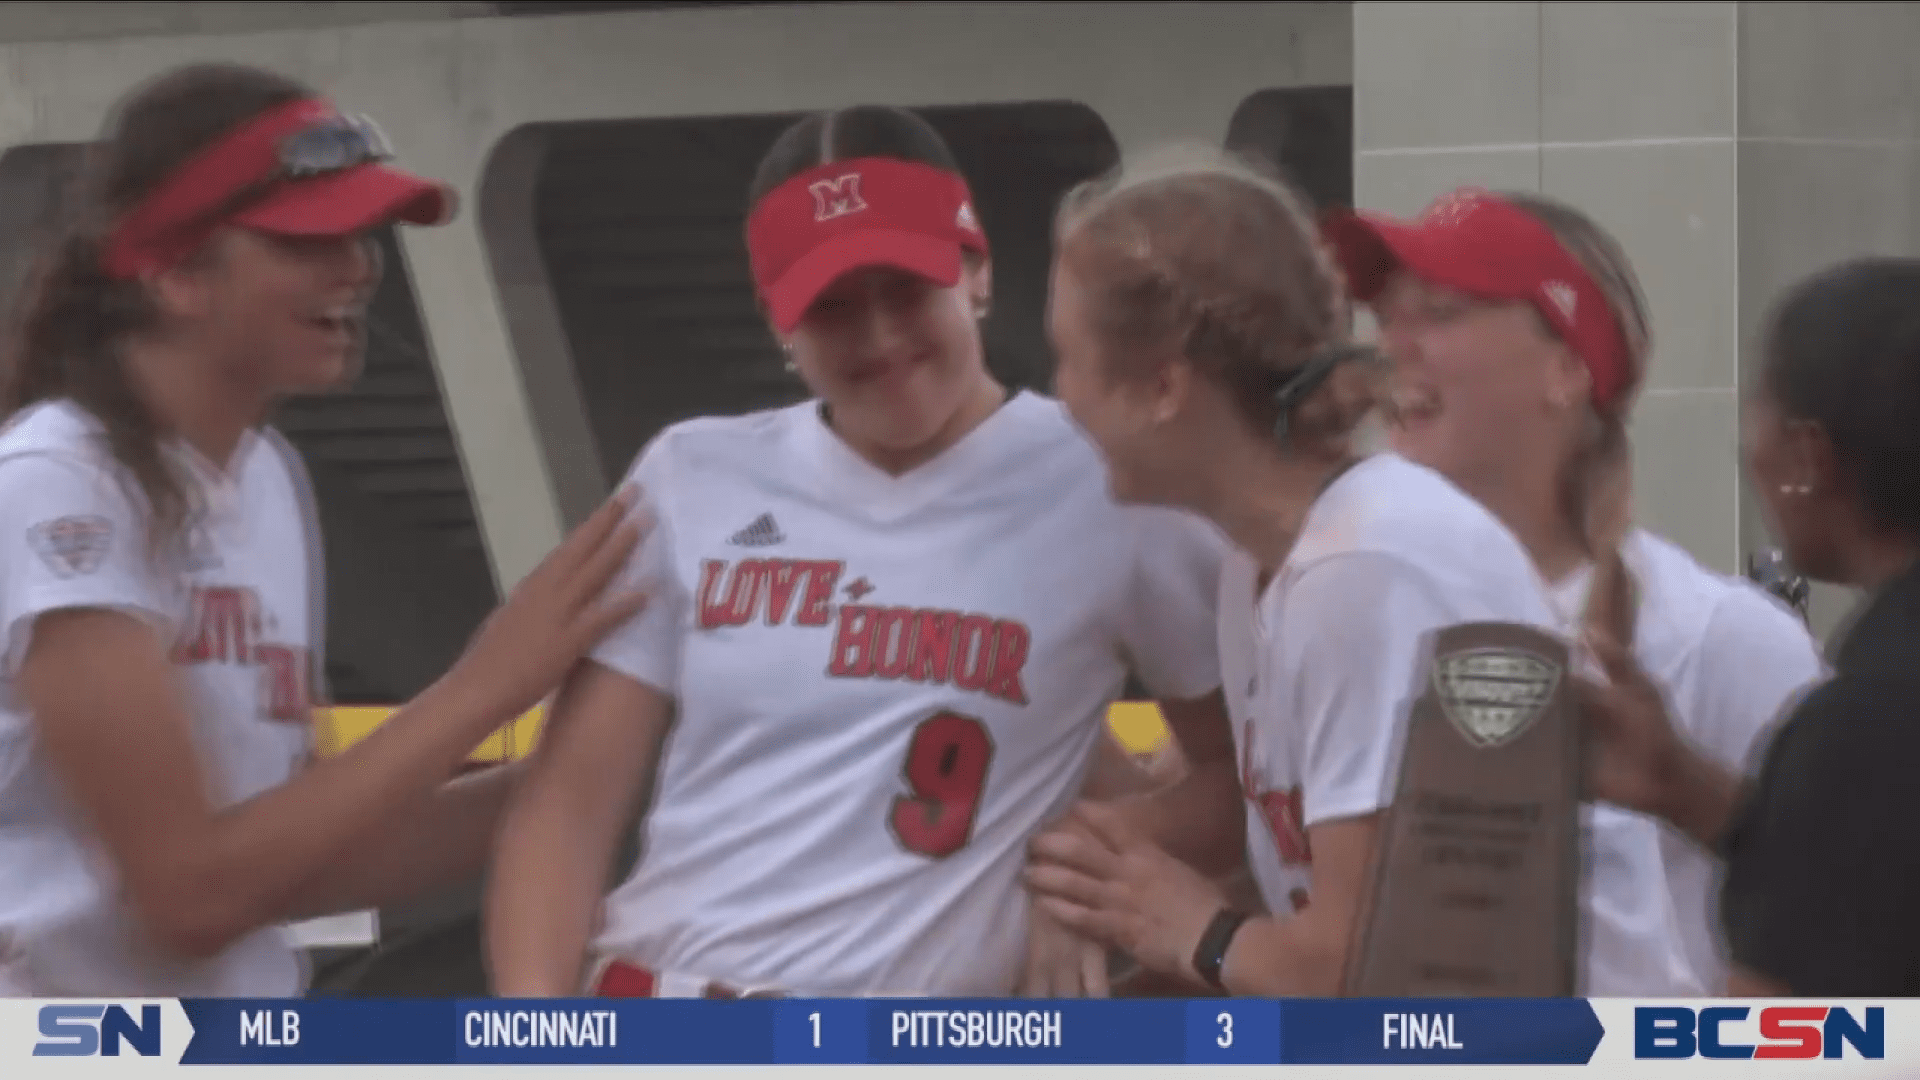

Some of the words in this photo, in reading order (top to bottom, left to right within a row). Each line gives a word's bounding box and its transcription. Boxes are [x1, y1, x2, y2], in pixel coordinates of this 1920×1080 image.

[808, 173, 868, 222] M
[696, 557, 846, 630] LOVE
[826, 604, 1031, 705] HONOR
[886, 711, 994, 858] 9
